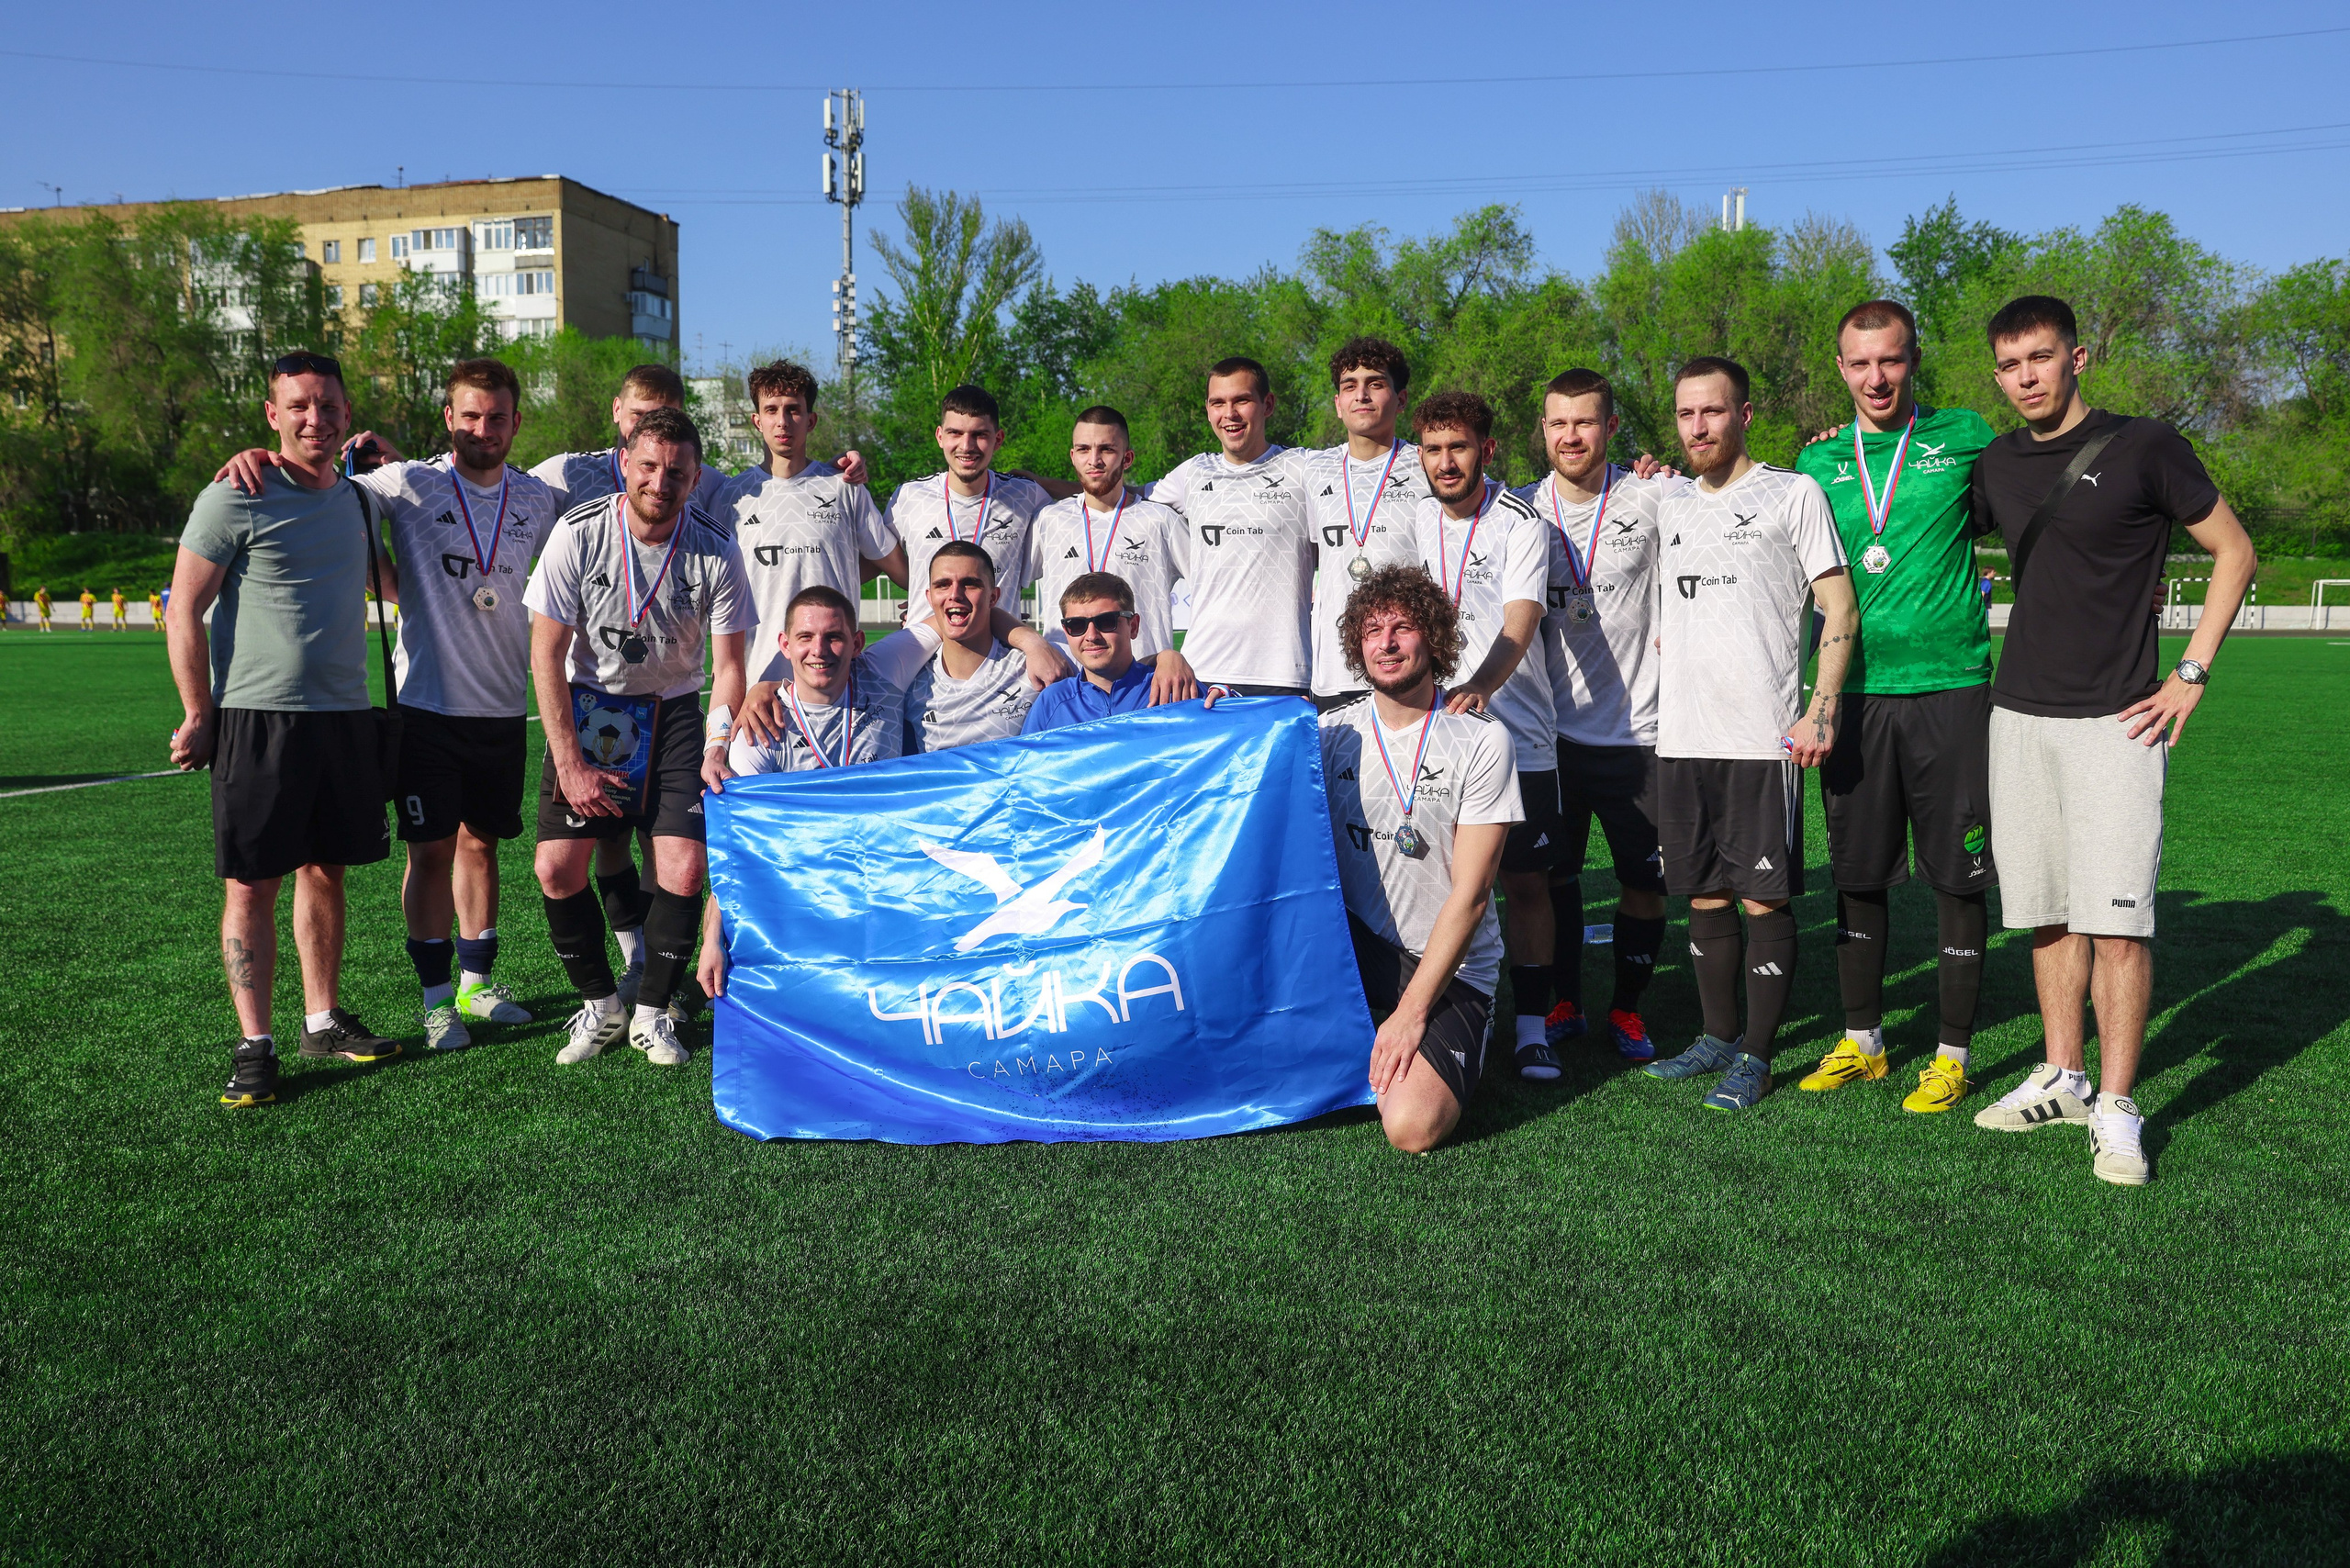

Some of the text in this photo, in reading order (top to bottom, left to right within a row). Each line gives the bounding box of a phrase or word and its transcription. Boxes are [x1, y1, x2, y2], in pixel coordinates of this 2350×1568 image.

[1908, 456, 1956, 469] ЧАЙКА
[1253, 490, 1292, 500] ЧАЙКА
[807, 510, 842, 520] ЧАЙКА
[502, 528, 533, 540] ЧАЙКА
[1226, 527, 1245, 535] Coin
[1247, 526, 1263, 534] Tab
[1371, 525, 1387, 533] Tab
[1723, 530, 1762, 540] ЧАЙКА
[1605, 535, 1647, 548] ЧАЙКА
[784, 546, 803, 554] Coin
[805, 545, 821, 554] Tab
[1613, 545, 1640, 554] САМАРА
[1114, 552, 1149, 563] ЧАЙКА
[498, 565, 513, 574] Tab
[1463, 568, 1493, 580] АЙКА
[1701, 577, 1719, 586] Coin
[1721, 575, 1738, 585] Tab
[1596, 583, 1616, 593] Tab
[1460, 611, 1475, 621] Tab
[659, 636, 677, 644] Tab
[406, 795, 425, 825] 9
[2111, 898, 2136, 909] PUMA
[1942, 946, 1978, 957] JÖGEL
[867, 953, 1185, 1046] ЧАЙКА
[968, 1047, 1113, 1080] САМАРА
